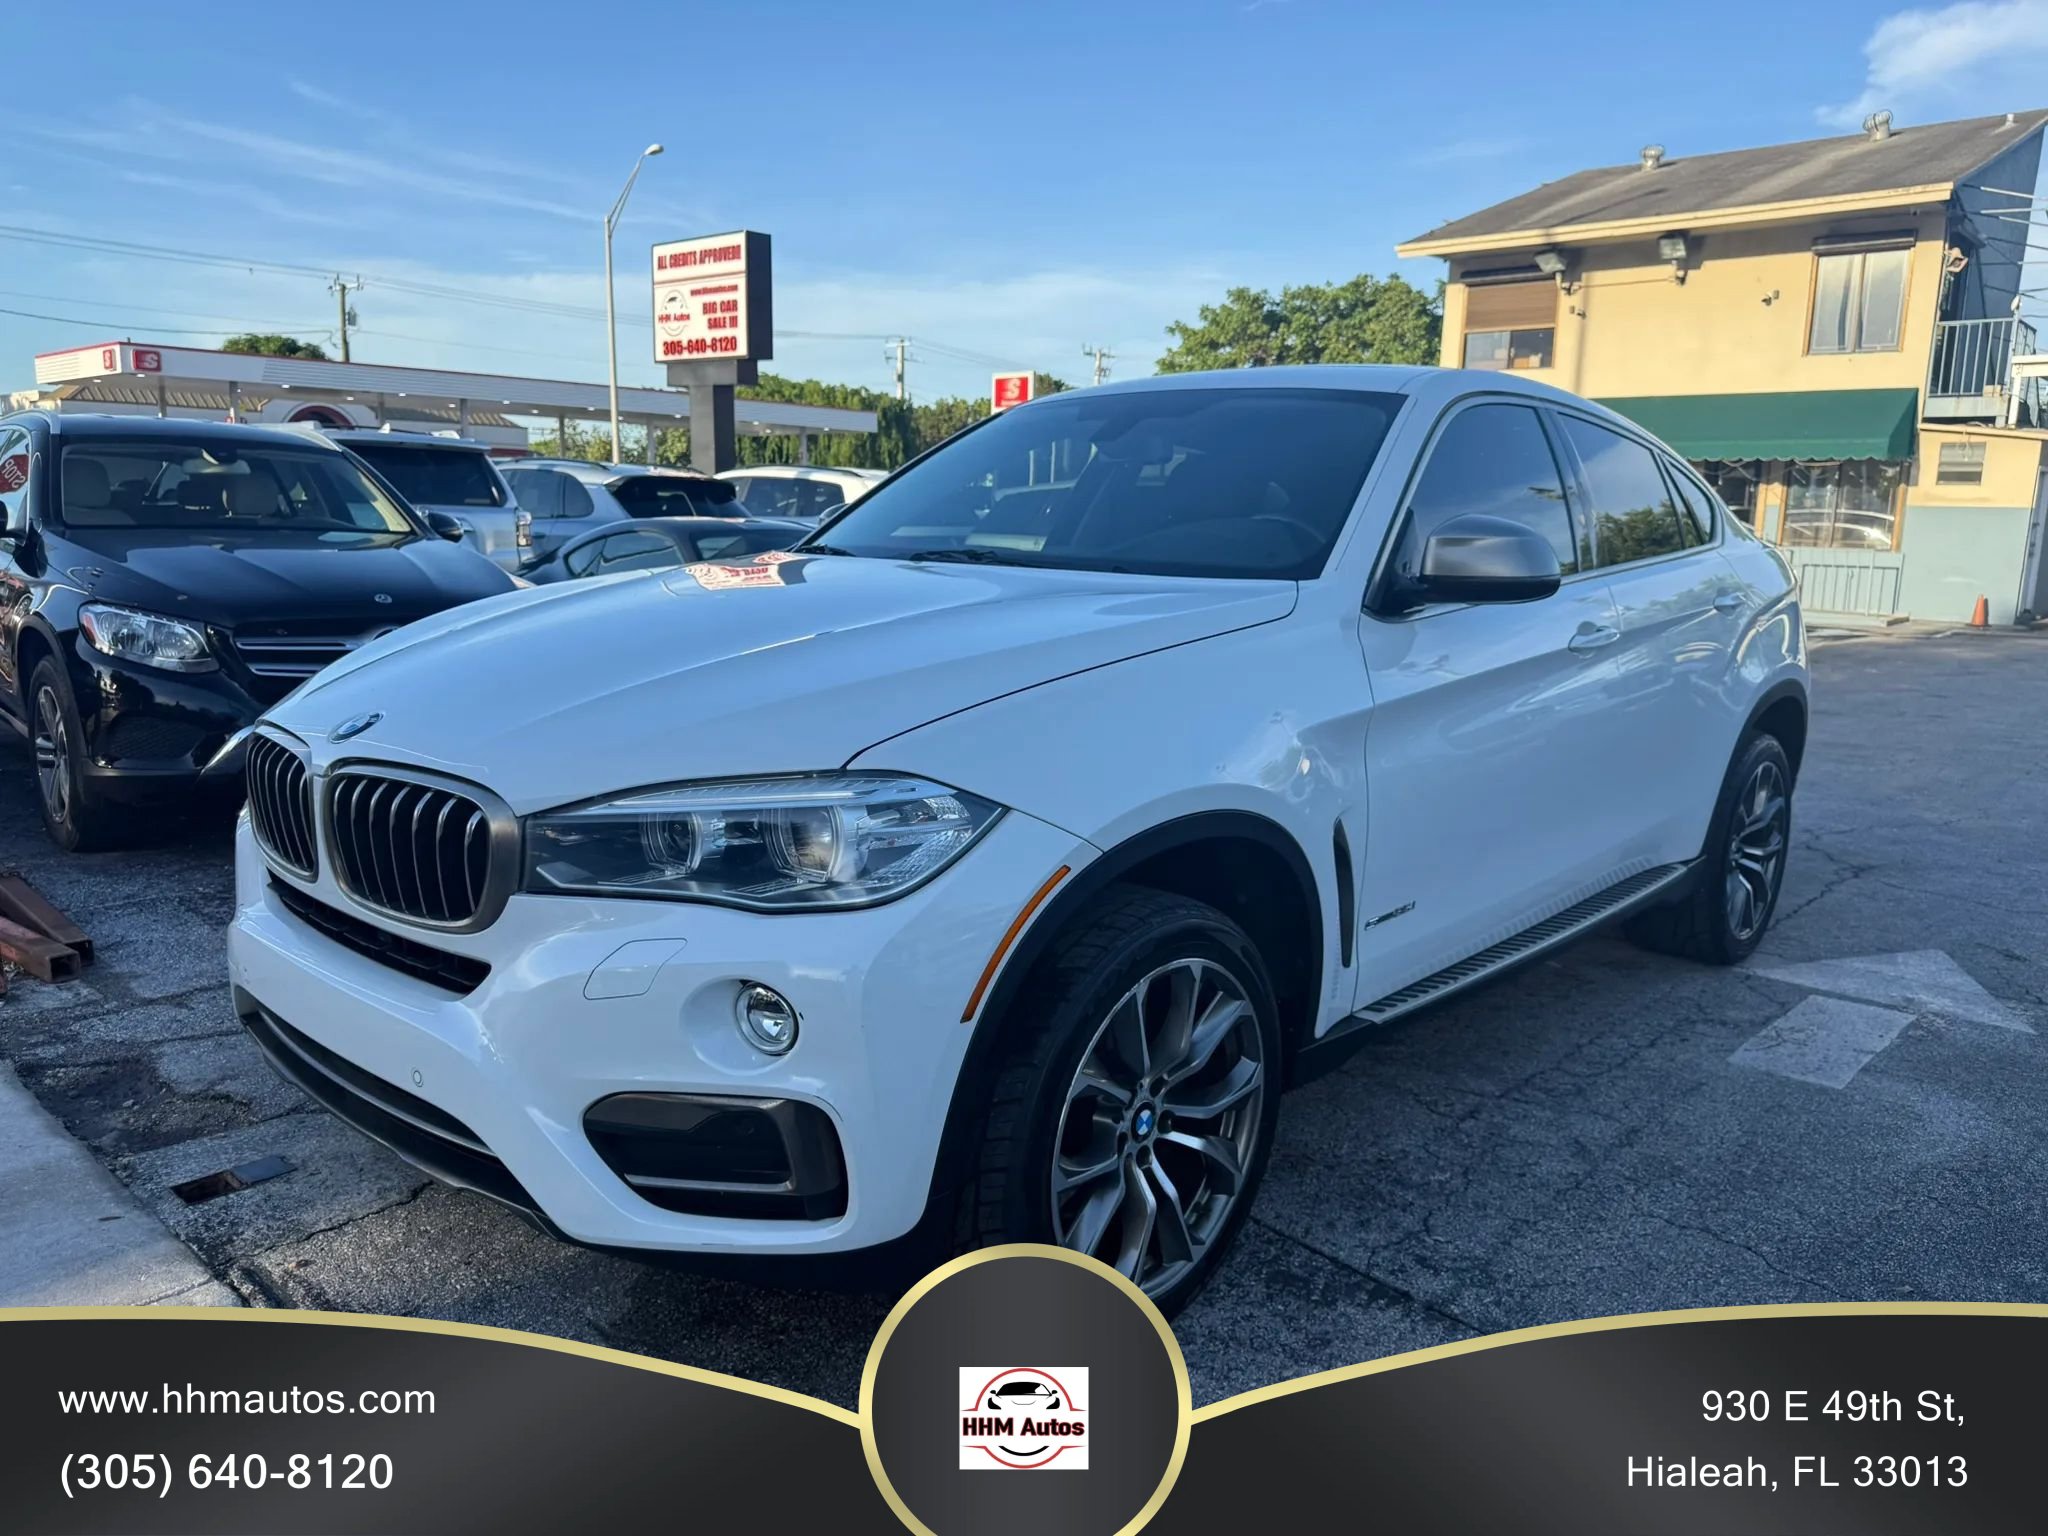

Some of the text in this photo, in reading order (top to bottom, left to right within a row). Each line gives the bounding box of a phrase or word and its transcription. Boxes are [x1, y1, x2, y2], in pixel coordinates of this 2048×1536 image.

[657, 255, 667, 271] ALL
[669, 250, 697, 268] CREDITS
[702, 299, 738, 315] BIG CAR
[707, 316, 727, 330] SALE
[663, 335, 737, 356] 305-640-8120
